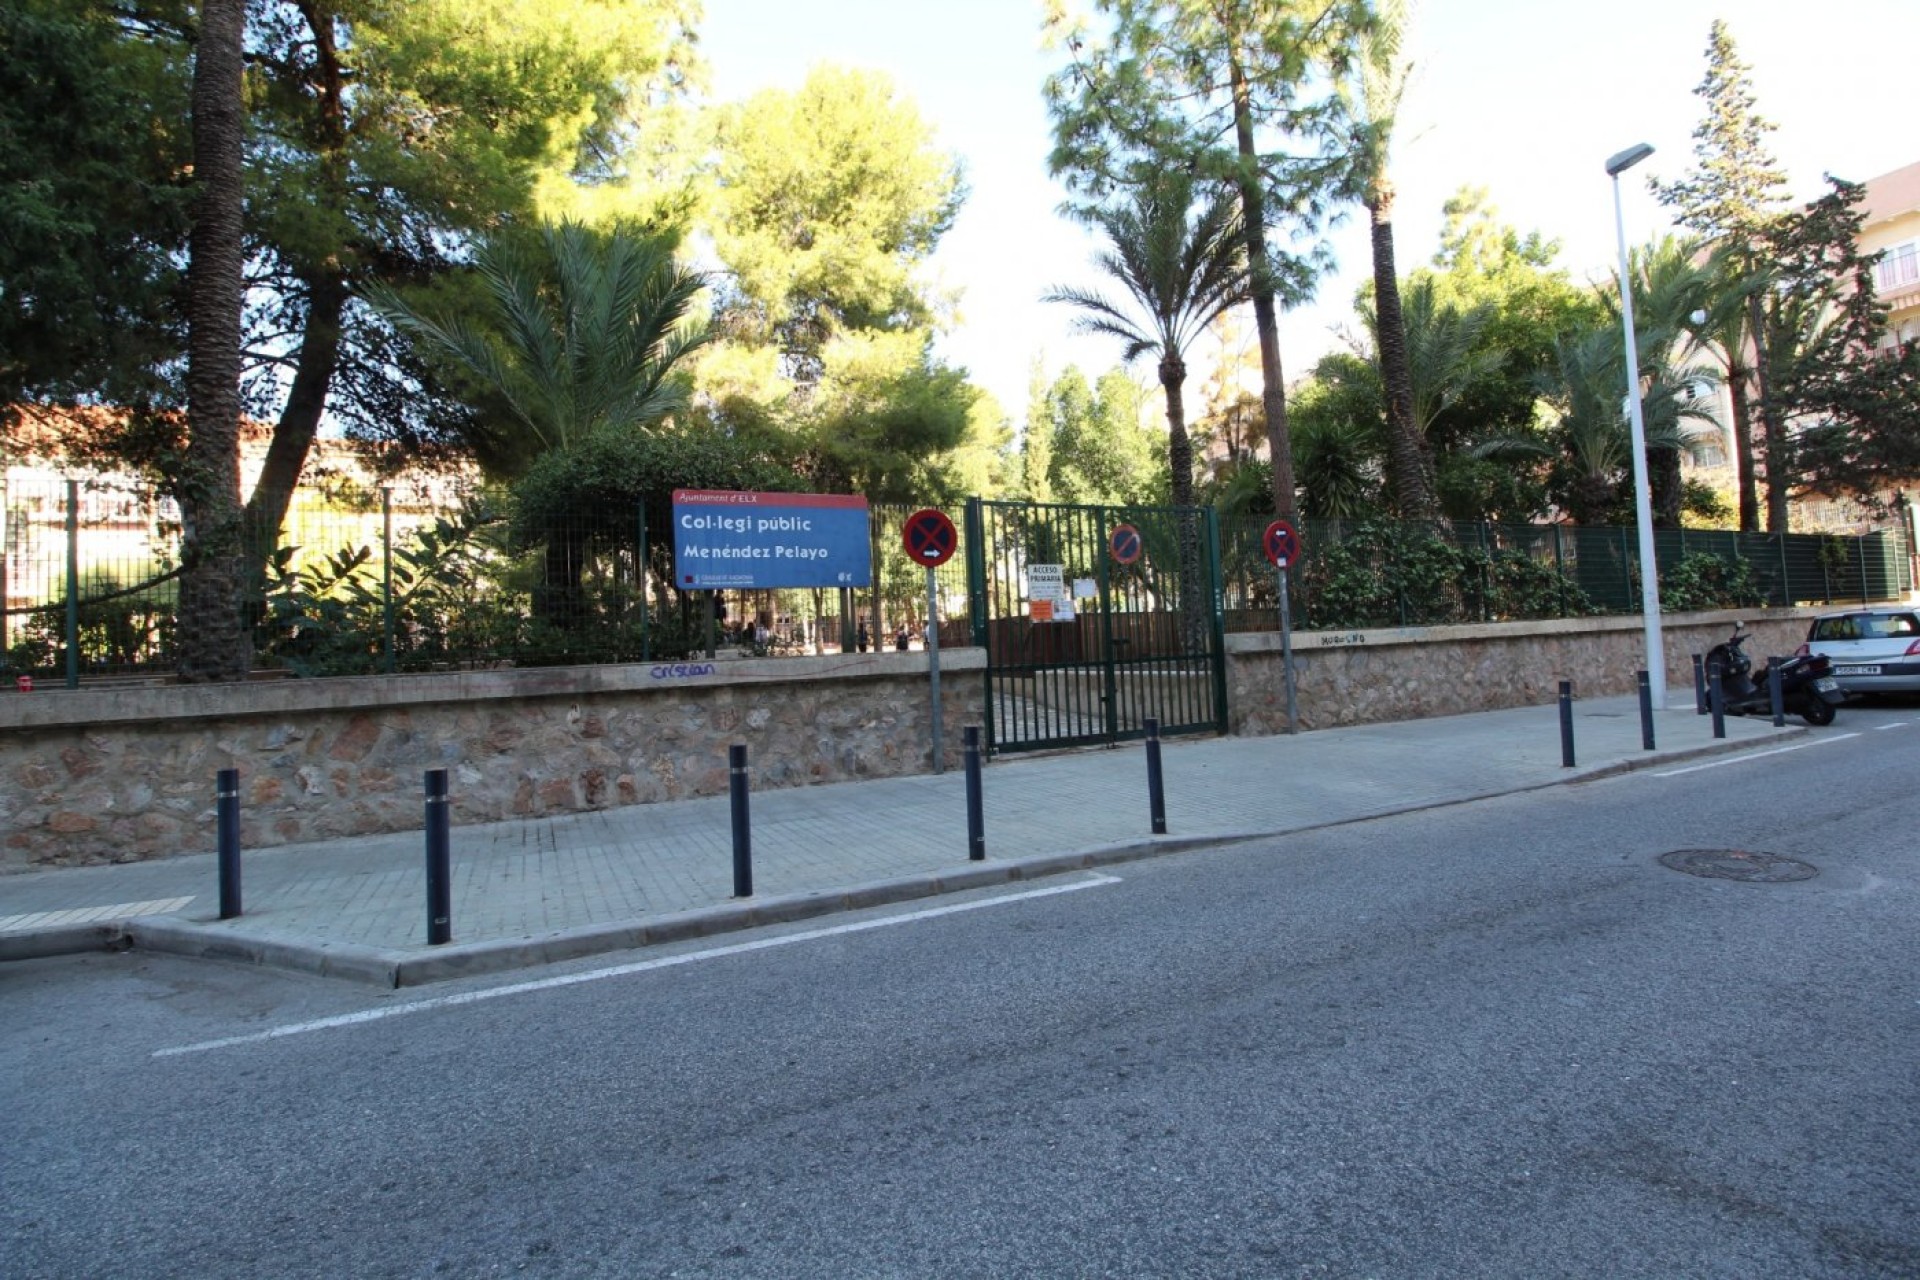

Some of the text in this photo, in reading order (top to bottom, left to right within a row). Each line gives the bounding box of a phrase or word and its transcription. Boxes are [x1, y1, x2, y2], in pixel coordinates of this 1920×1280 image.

[680, 493, 728, 503] Ajuntament
[758, 516, 812, 533] públic
[684, 543, 828, 560] Menéndez Pelayo
